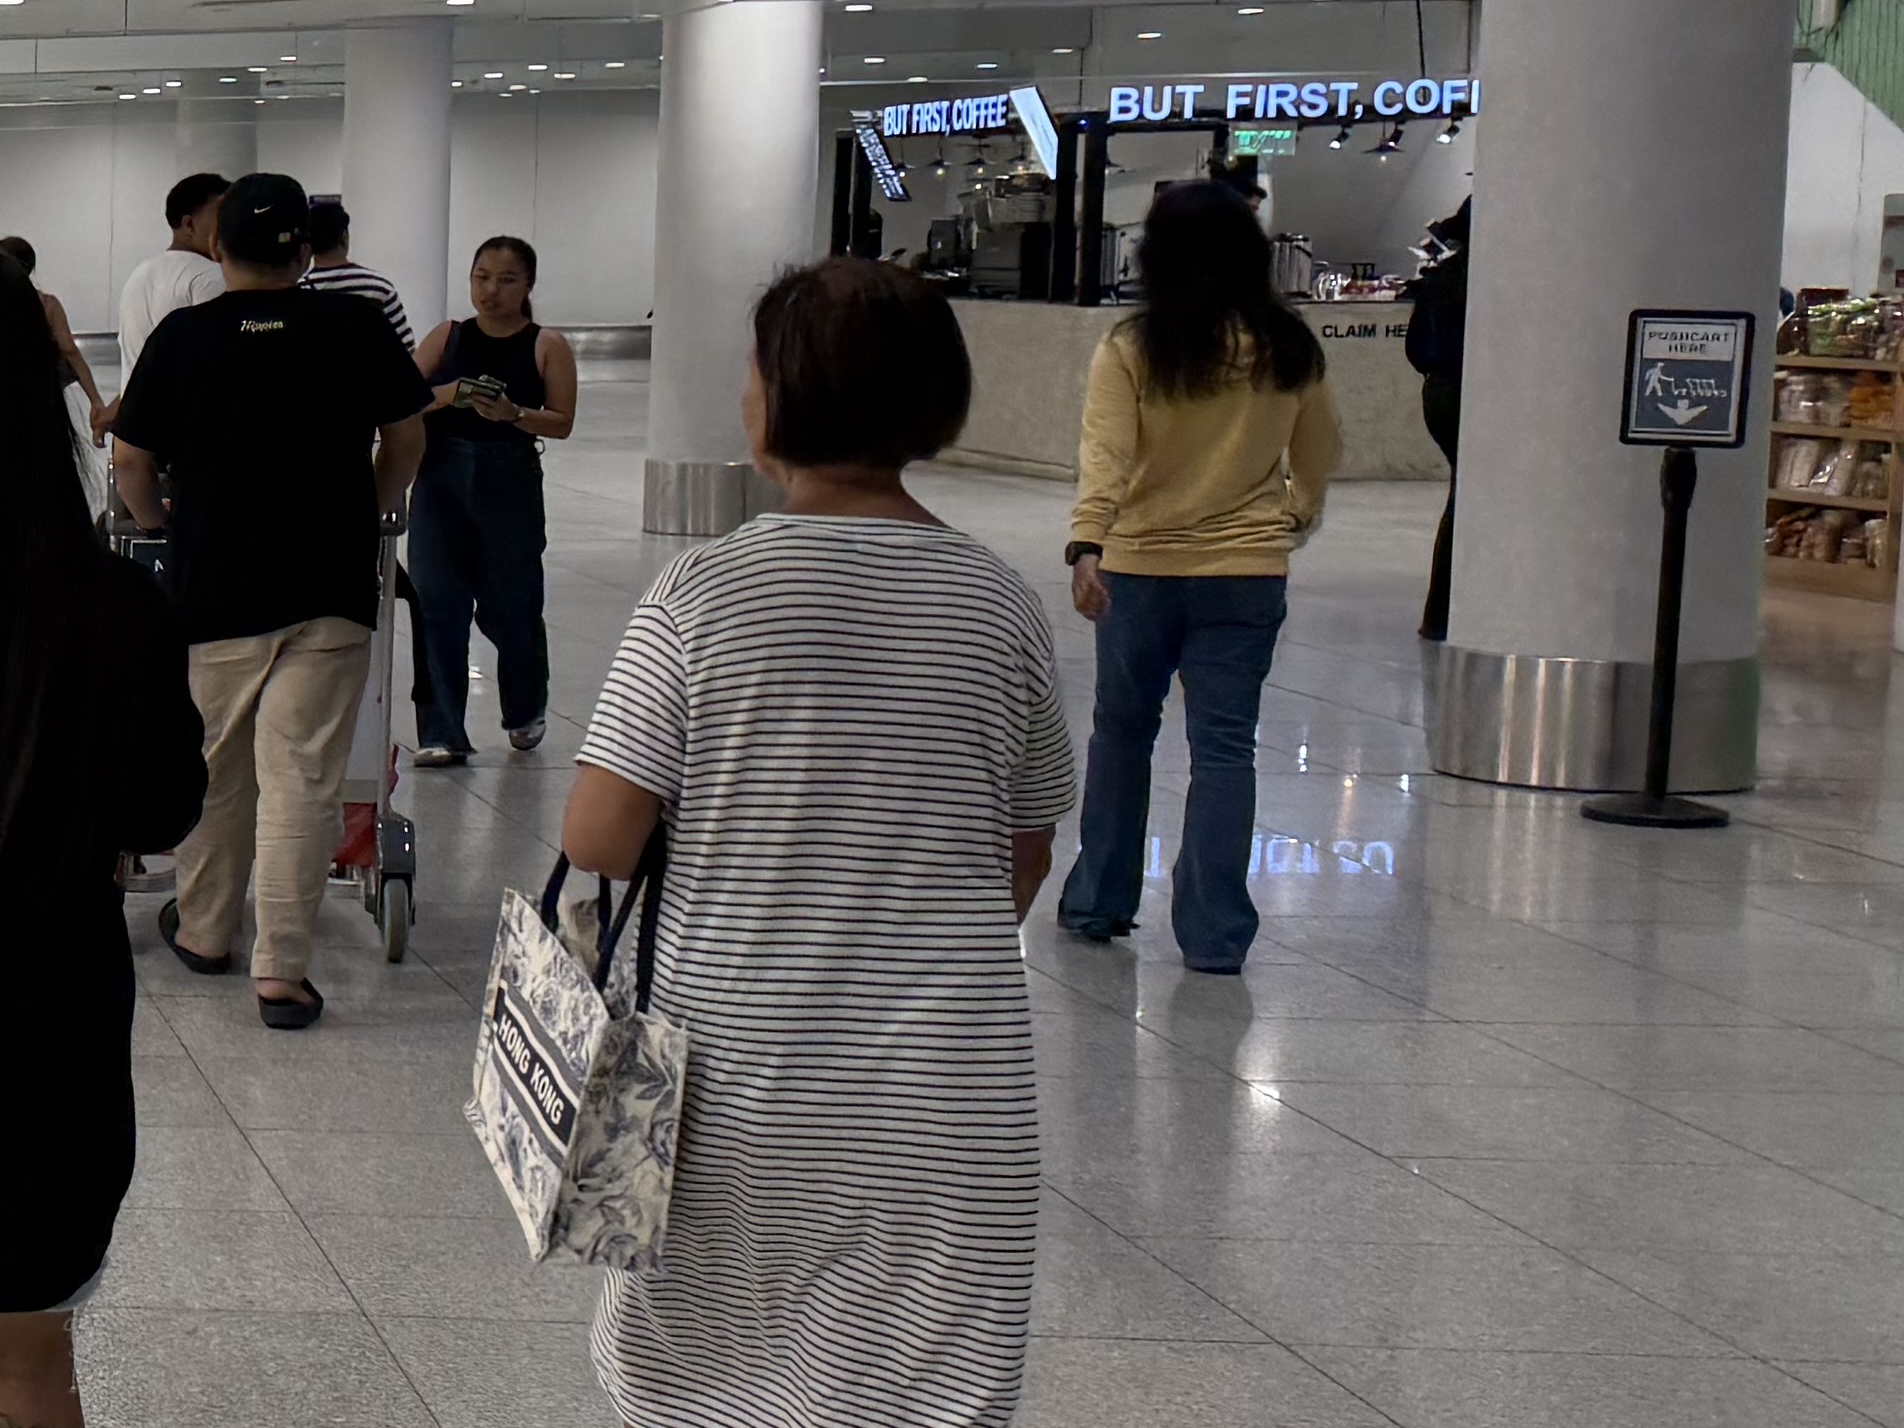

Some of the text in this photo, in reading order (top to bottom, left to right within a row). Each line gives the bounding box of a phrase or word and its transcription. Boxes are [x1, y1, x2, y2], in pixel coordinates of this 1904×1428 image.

[884, 94, 1008, 137] BUT FIRST, COFFEE
[1109, 85, 1204, 121] BUT
[1227, 82, 1363, 119] FIRST,
[1322, 324, 1409, 338] CLAIM HE
[498, 1014, 564, 1124] HONG KONG
